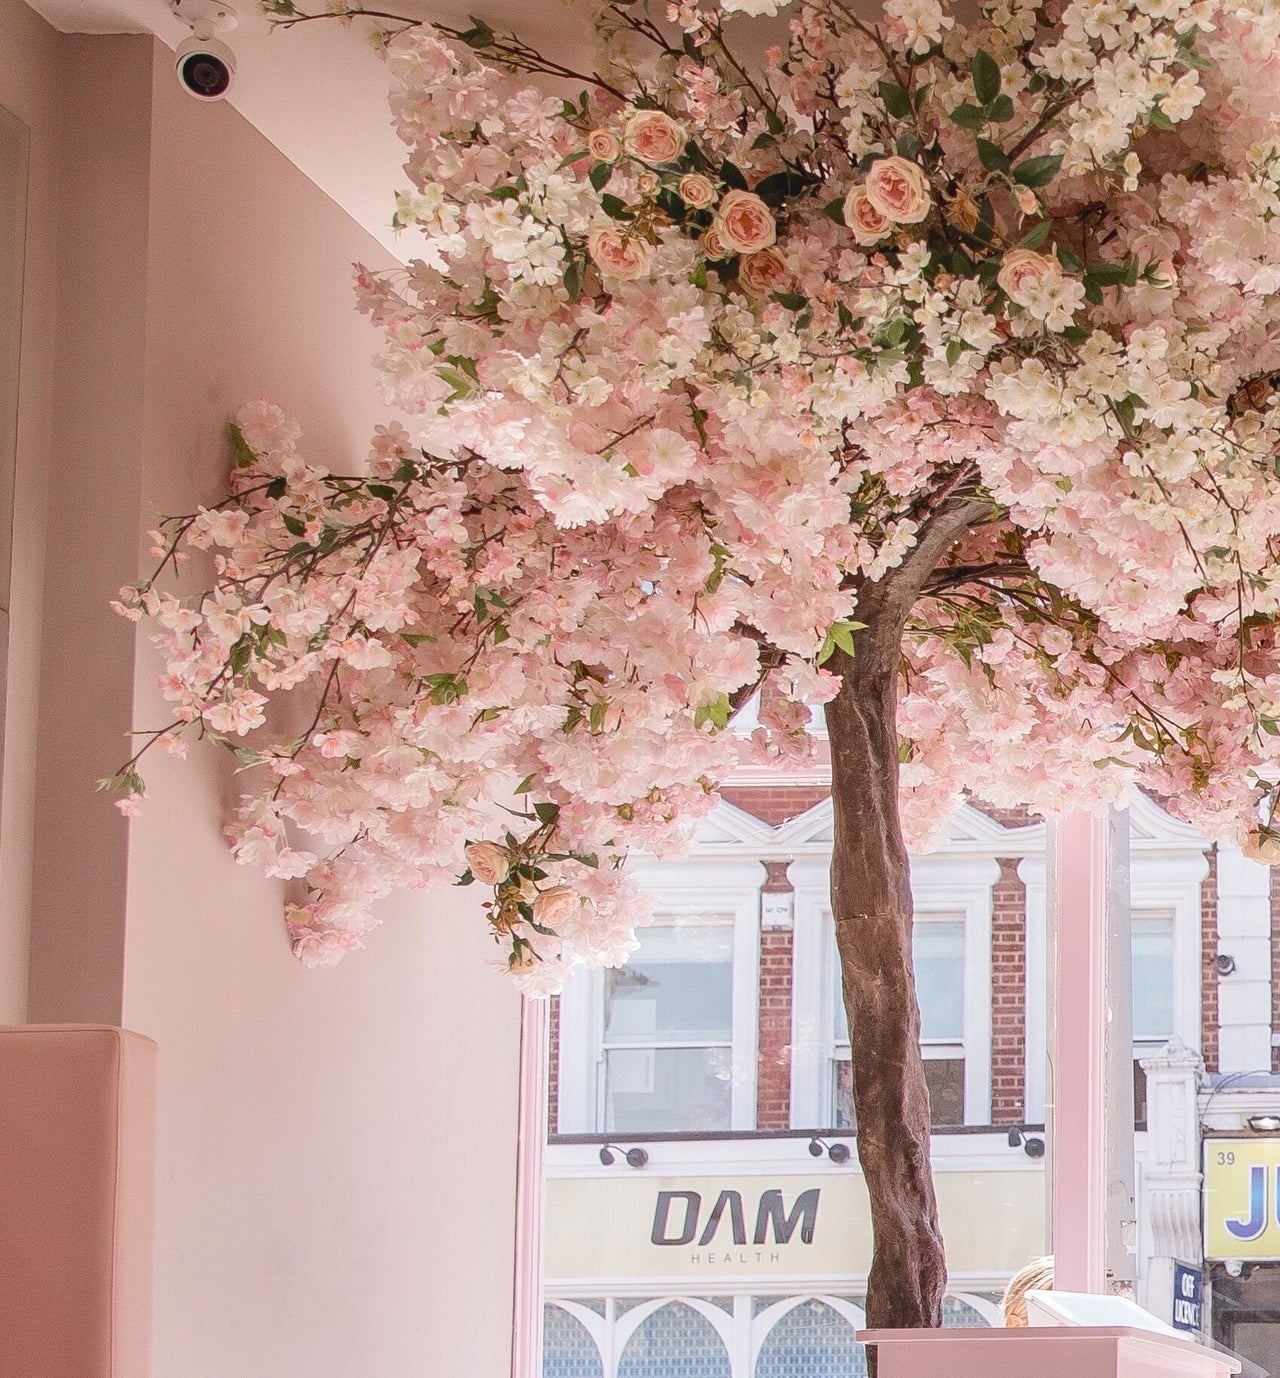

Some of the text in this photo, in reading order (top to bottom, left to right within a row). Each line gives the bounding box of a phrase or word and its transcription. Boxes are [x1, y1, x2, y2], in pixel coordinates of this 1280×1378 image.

[1216, 1151, 1236, 1167] 39
[651, 1188, 821, 1246] DAM
[691, 1252, 780, 1265] HEALTH
[1181, 1271, 1196, 1299] OFF
